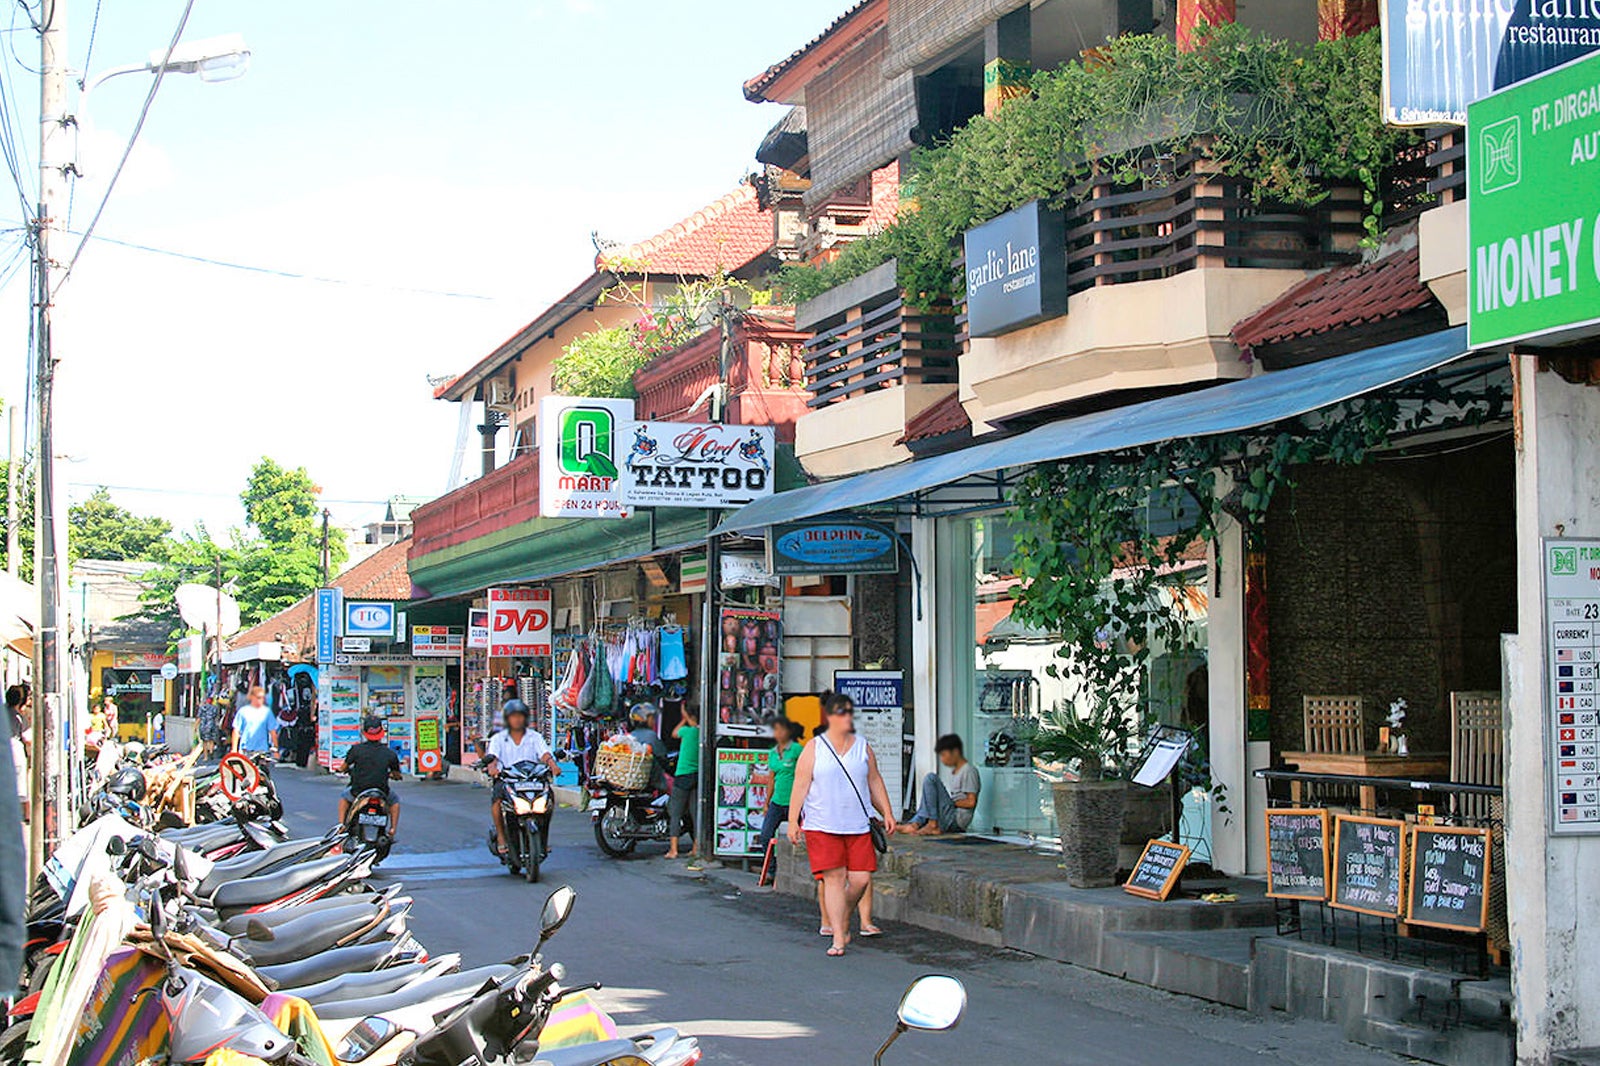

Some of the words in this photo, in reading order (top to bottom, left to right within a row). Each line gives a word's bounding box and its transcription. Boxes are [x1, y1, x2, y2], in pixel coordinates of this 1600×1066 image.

[1508, 23, 1600, 47] restauran
[1531, 103, 1551, 136] PT.
[1554, 84, 1600, 128] DIRGA
[1570, 131, 1600, 166] AU
[969, 249, 1005, 297] garlic
[1007, 241, 1036, 275] lane
[1476, 217, 1584, 314] MONEY
[631, 465, 766, 490] TATTOO
[553, 499, 578, 510] OPEN
[581, 499, 592, 510] 24
[803, 530, 863, 542] DOLPHIN
[358, 610, 382, 623] TIC
[493, 609, 549, 636] DVD
[1584, 603, 1599, 620] 23
[1556, 629, 1590, 640] CURRENCY
[1579, 651, 1592, 661] USD
[866, 686, 897, 706] CHANGER
[719, 753, 755, 762] DANTE
[227, 760, 247, 794] P
